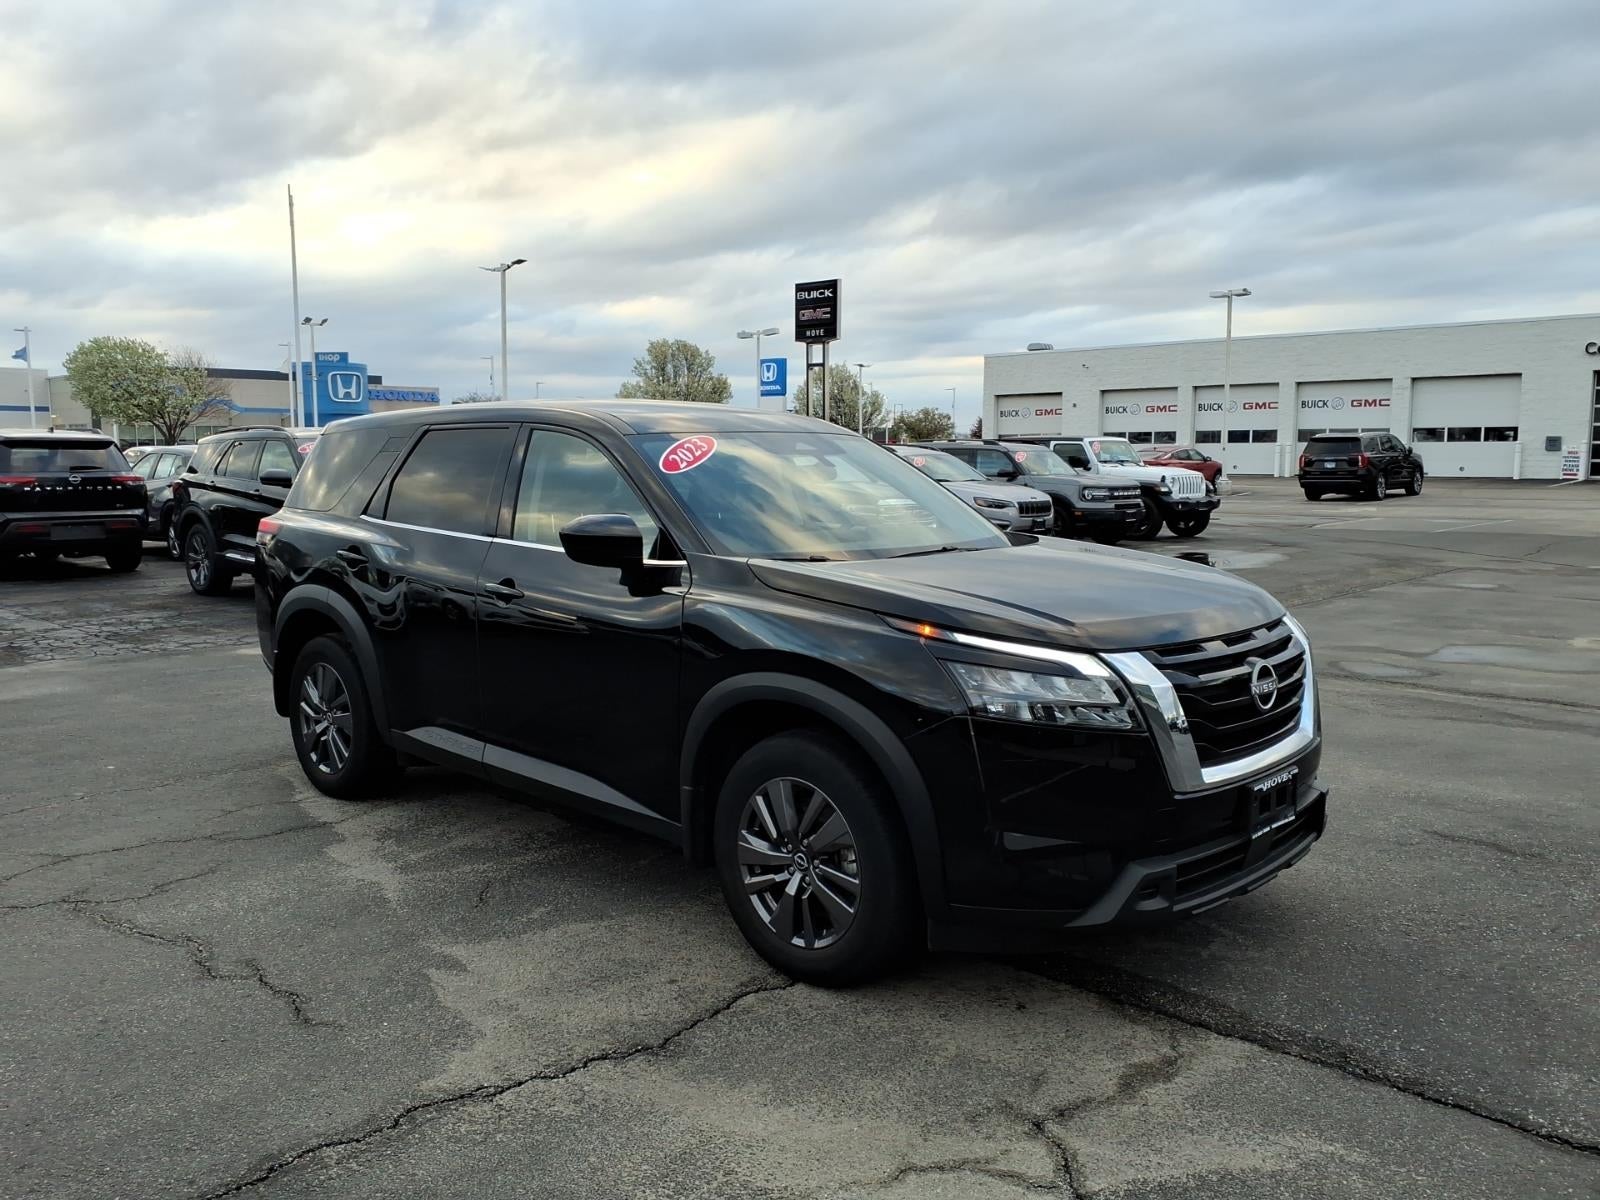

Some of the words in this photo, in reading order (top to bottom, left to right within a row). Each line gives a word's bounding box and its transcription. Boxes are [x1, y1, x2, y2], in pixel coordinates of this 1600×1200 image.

[796, 288, 834, 300] BUICK
[799, 307, 831, 320] GMC
[805, 329, 825, 337] HOYE
[367, 389, 440, 402] HONDA
[1198, 402, 1223, 412] BUICK
[1243, 401, 1279, 410] GMC
[1301, 399, 1329, 409] BUICK
[1350, 398, 1391, 408] GMC
[999, 409, 1020, 418] BUICK
[1034, 408, 1063, 416] GMC
[1105, 406, 1128, 415] BUICK
[1145, 404, 1178, 413] GMC
[669, 438, 708, 469] 2023
